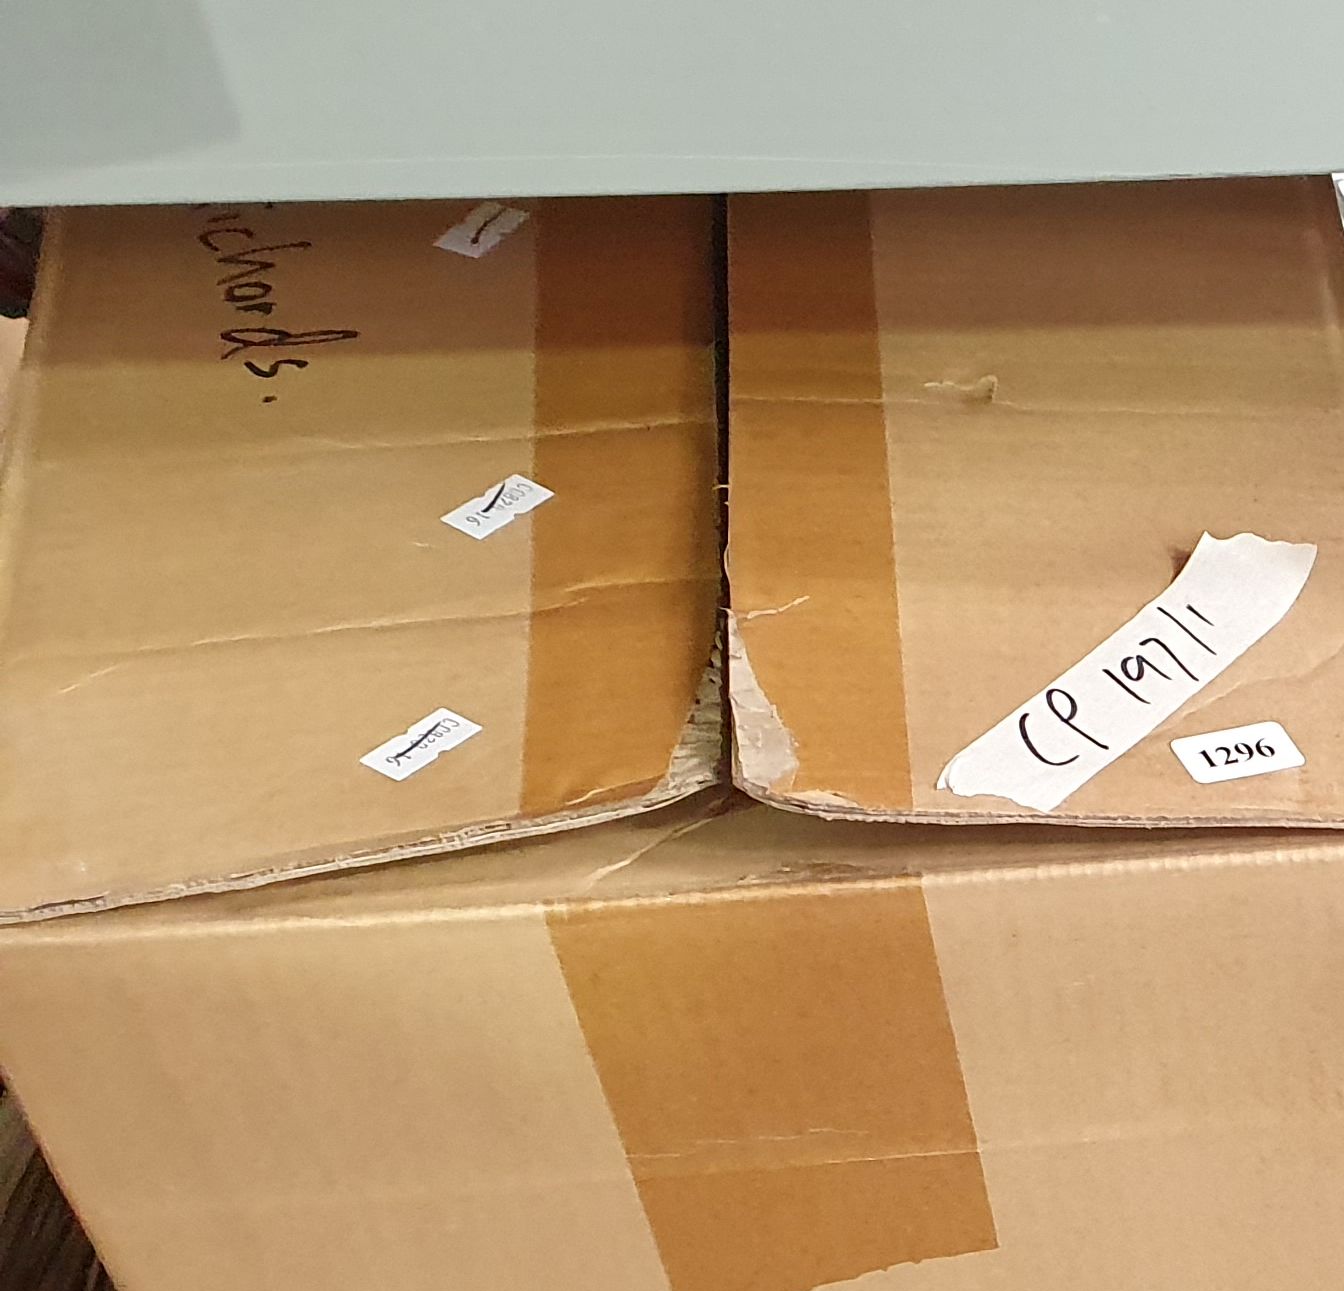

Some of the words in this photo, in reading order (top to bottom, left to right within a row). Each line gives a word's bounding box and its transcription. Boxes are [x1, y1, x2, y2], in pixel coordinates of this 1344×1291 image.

[1019, 688, 1109, 766] CP
[1102, 603, 1217, 704] 197/1
[1198, 737, 1276, 770] 1296
